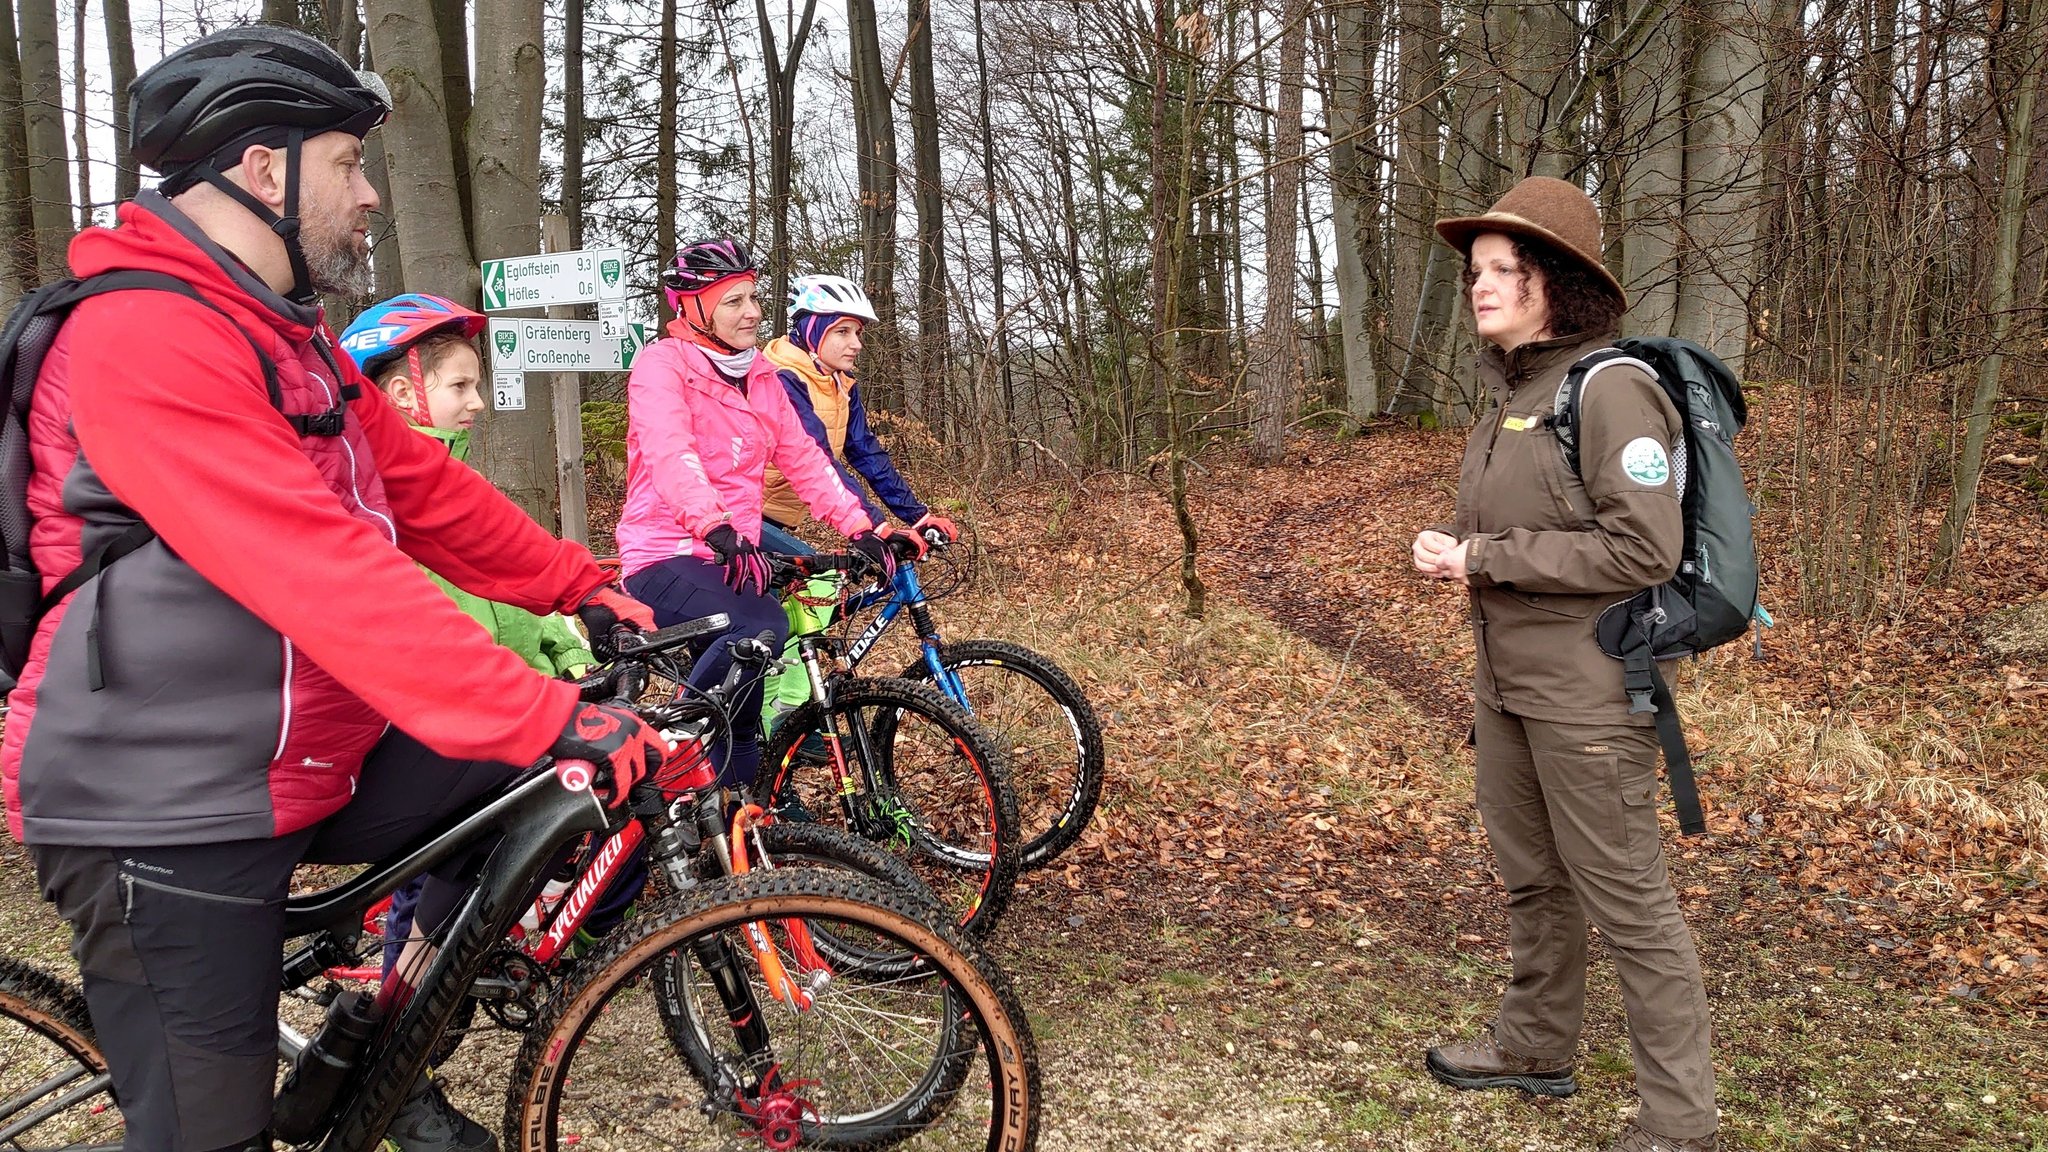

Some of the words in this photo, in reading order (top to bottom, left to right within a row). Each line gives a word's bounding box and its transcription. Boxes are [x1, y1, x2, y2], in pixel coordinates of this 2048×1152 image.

[506, 261, 560, 281] Egloffstein
[577, 257, 592, 272] 9,3
[602, 261, 618, 270] BIKE
[508, 286, 540, 301] Höfles
[578, 281, 593, 296] 0,6
[497, 331, 514, 340] BIKE
[525, 325, 591, 344] Gräfenberg
[602, 320, 616, 336] 3.3
[340, 326, 400, 350] MET
[527, 349, 591, 364] Großenohe
[498, 390, 512, 406] 3.1
[549, 833, 623, 949] SPECIALIZED
[1006, 1069, 1021, 1129] RAY
